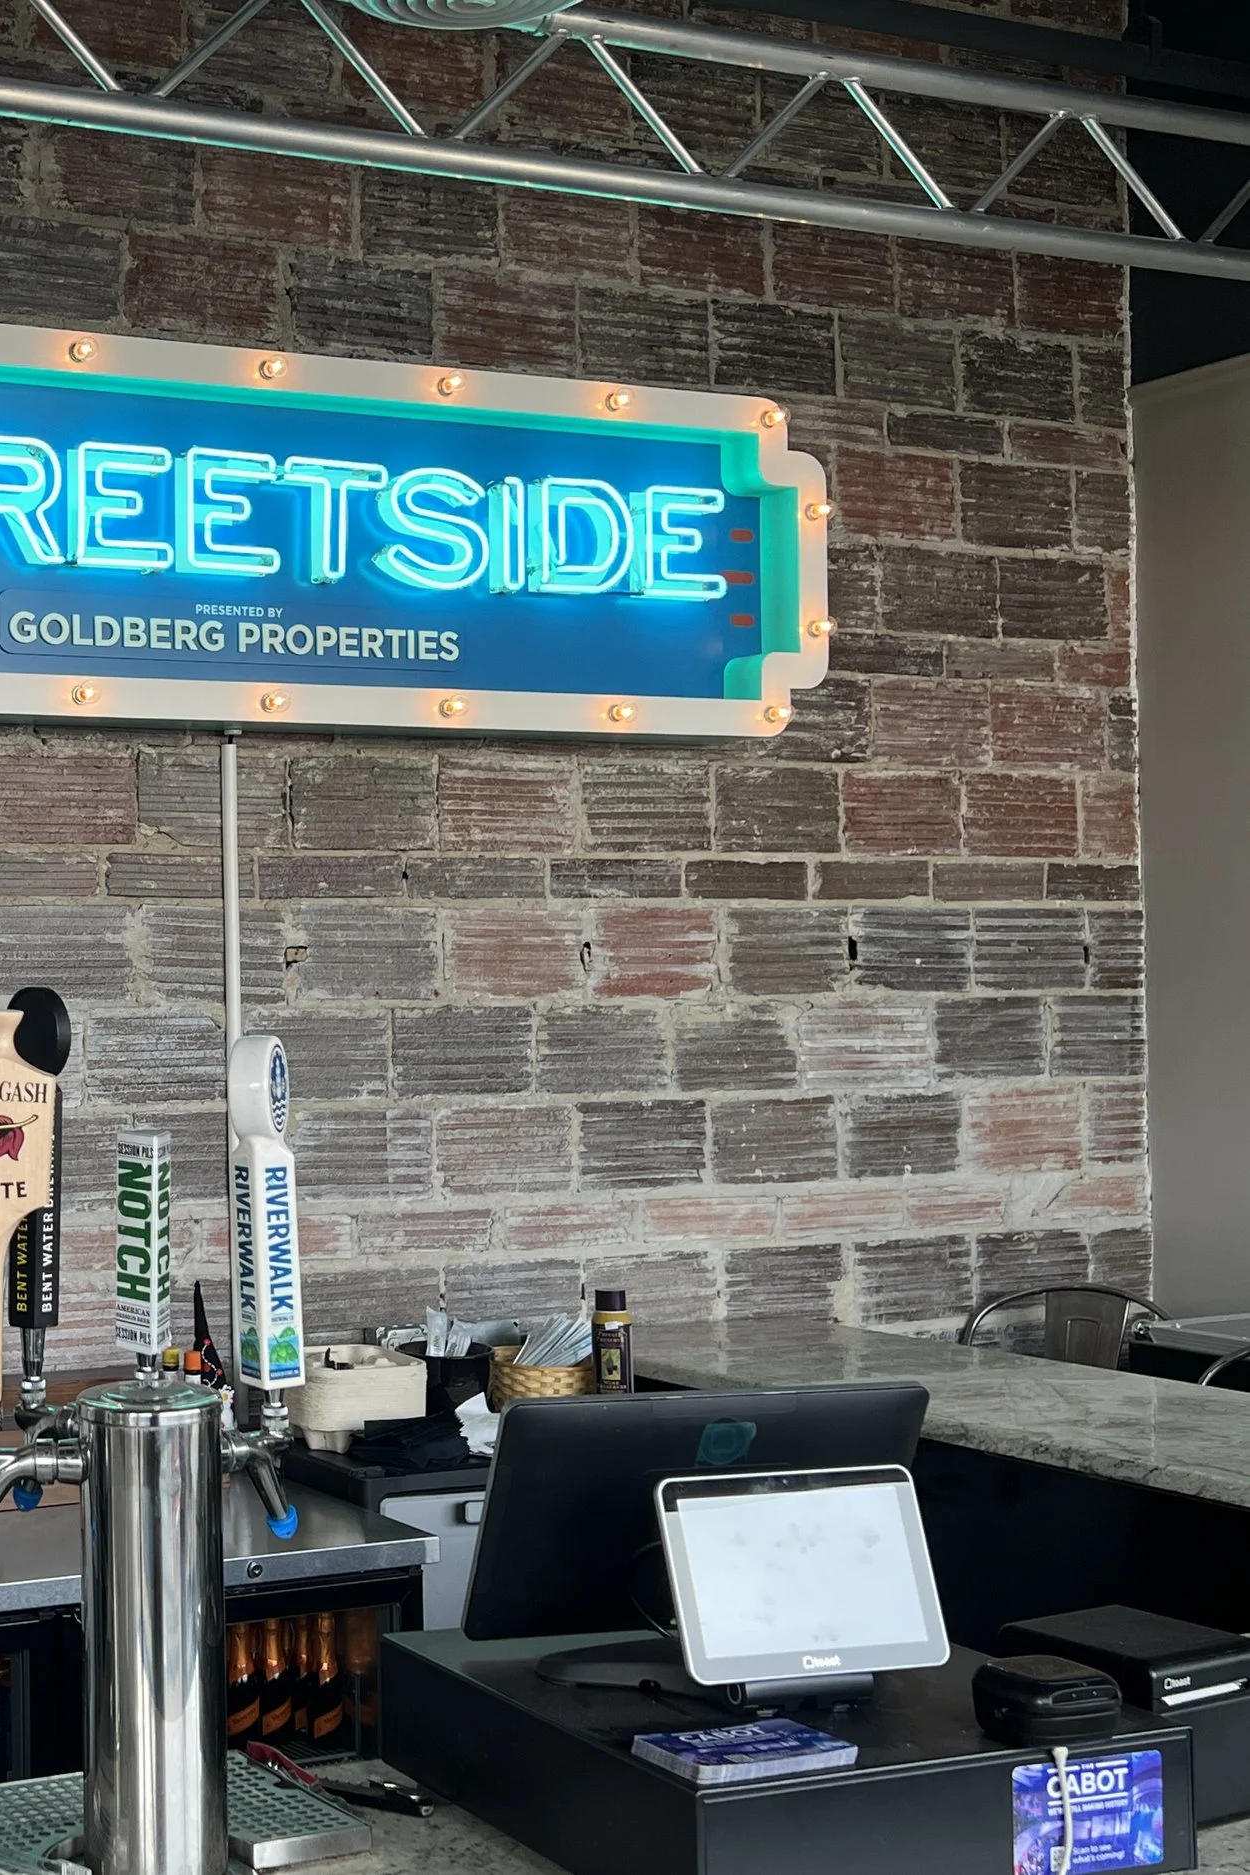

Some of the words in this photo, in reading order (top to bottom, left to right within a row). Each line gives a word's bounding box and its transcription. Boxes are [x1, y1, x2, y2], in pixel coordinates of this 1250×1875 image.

[195, 603, 264, 618] PRESENTED
[267, 606, 283, 619] BY
[8, 610, 226, 652] GOLDBERG
[238, 622, 460, 662] PROPERTIES
[117, 1142, 141, 1157] SESSION
[42, 1212, 53, 1269] WATER
[116, 1159, 152, 1303] NOTCH
[157, 1159, 171, 1303] NOTCH
[234, 1164, 257, 1313] RIVERWALK
[264, 1166, 295, 1313] RIVERWALK
[16, 1272, 28, 1313] BENT
[42, 1271, 53, 1313] BENT
[116, 1304, 150, 1317] AMERICAN
[115, 1325, 137, 1341] SESSION
[678, 1726, 767, 1744] CABOT
[1046, 1767, 1129, 1799] CABOT
